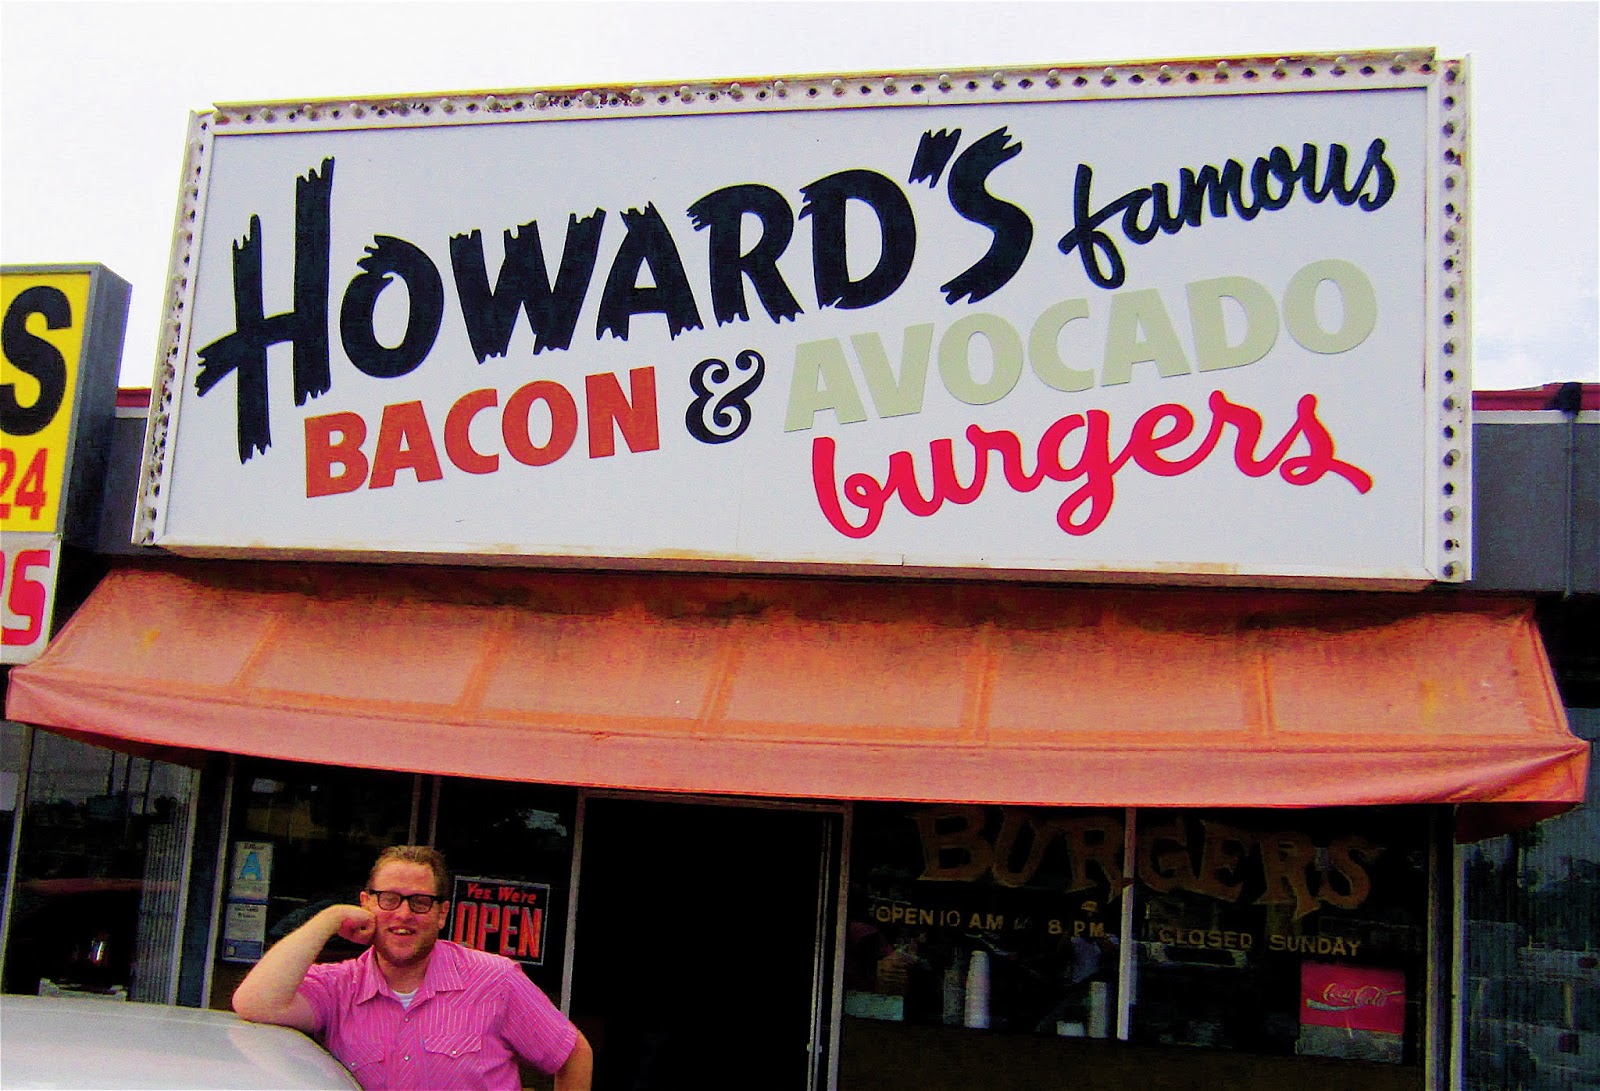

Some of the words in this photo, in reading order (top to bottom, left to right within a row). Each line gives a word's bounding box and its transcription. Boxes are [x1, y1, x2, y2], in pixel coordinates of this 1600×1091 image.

[1057, 138, 1397, 290] famous
[304, 366, 660, 498] BACON
[685, 349, 766, 444] &
[784, 259, 1379, 432] AVOCADO
[811, 390, 1374, 539] burgers
[240, 852, 262, 880] A
[906, 805, 1386, 920] BURGERS
[453, 900, 543, 959] OPEN
[875, 905, 934, 927] OPEN
[939, 909, 961, 928] 10
[1047, 918, 1063, 936] 8
[1158, 927, 1254, 951] CLOSED
[1268, 933, 1362, 957] SUNDAY
